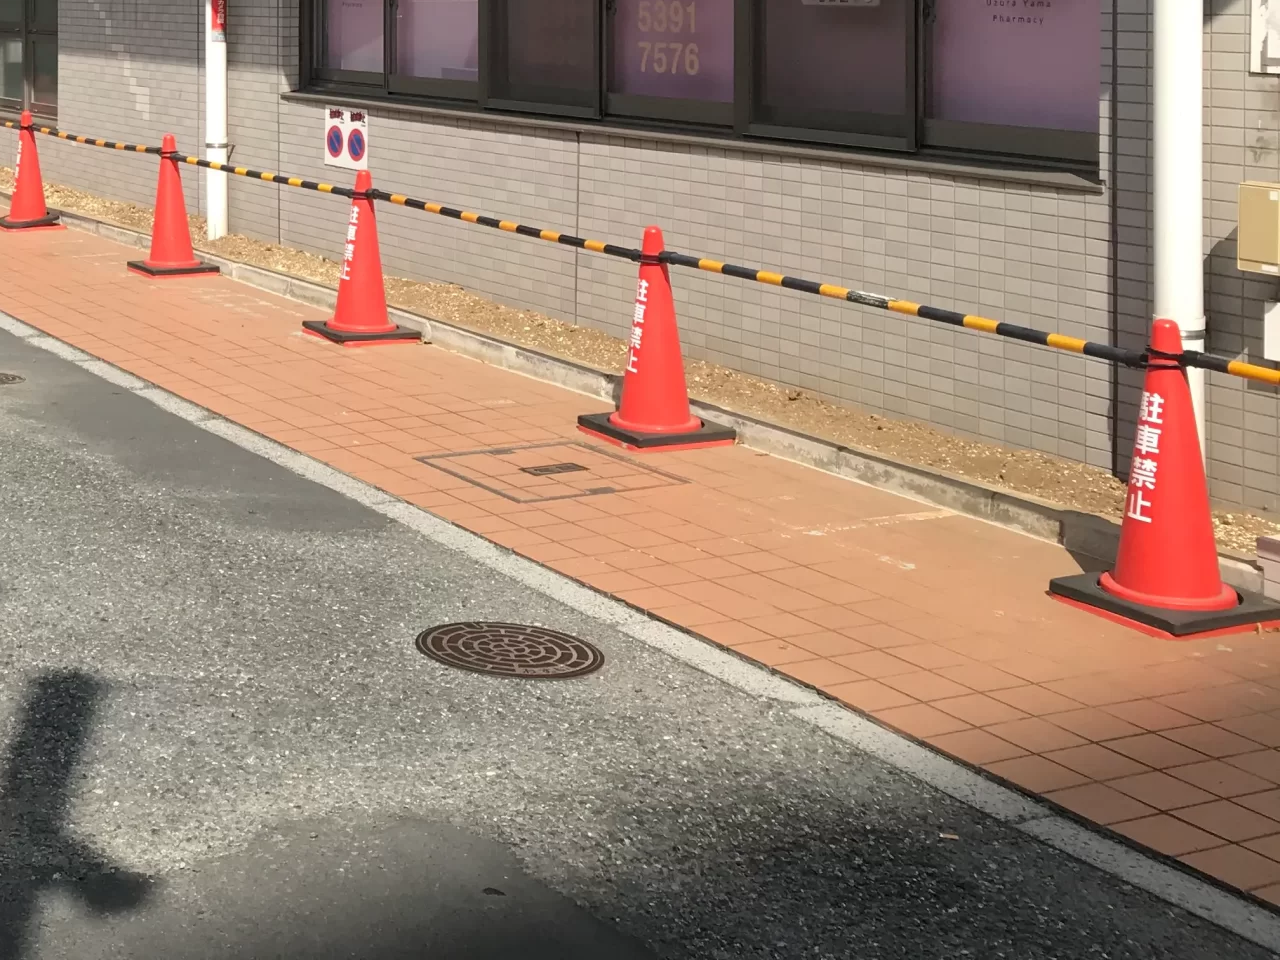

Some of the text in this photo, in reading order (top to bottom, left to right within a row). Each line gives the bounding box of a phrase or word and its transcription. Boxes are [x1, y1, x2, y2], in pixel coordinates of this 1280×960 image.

[637, 0, 696, 34] 5391
[992, 14, 1044, 26] Pharmacy
[1023, 0, 1051, 8] Yama
[637, 41, 700, 76] 7576
[1127, 391, 1165, 524] 駐車禁止
